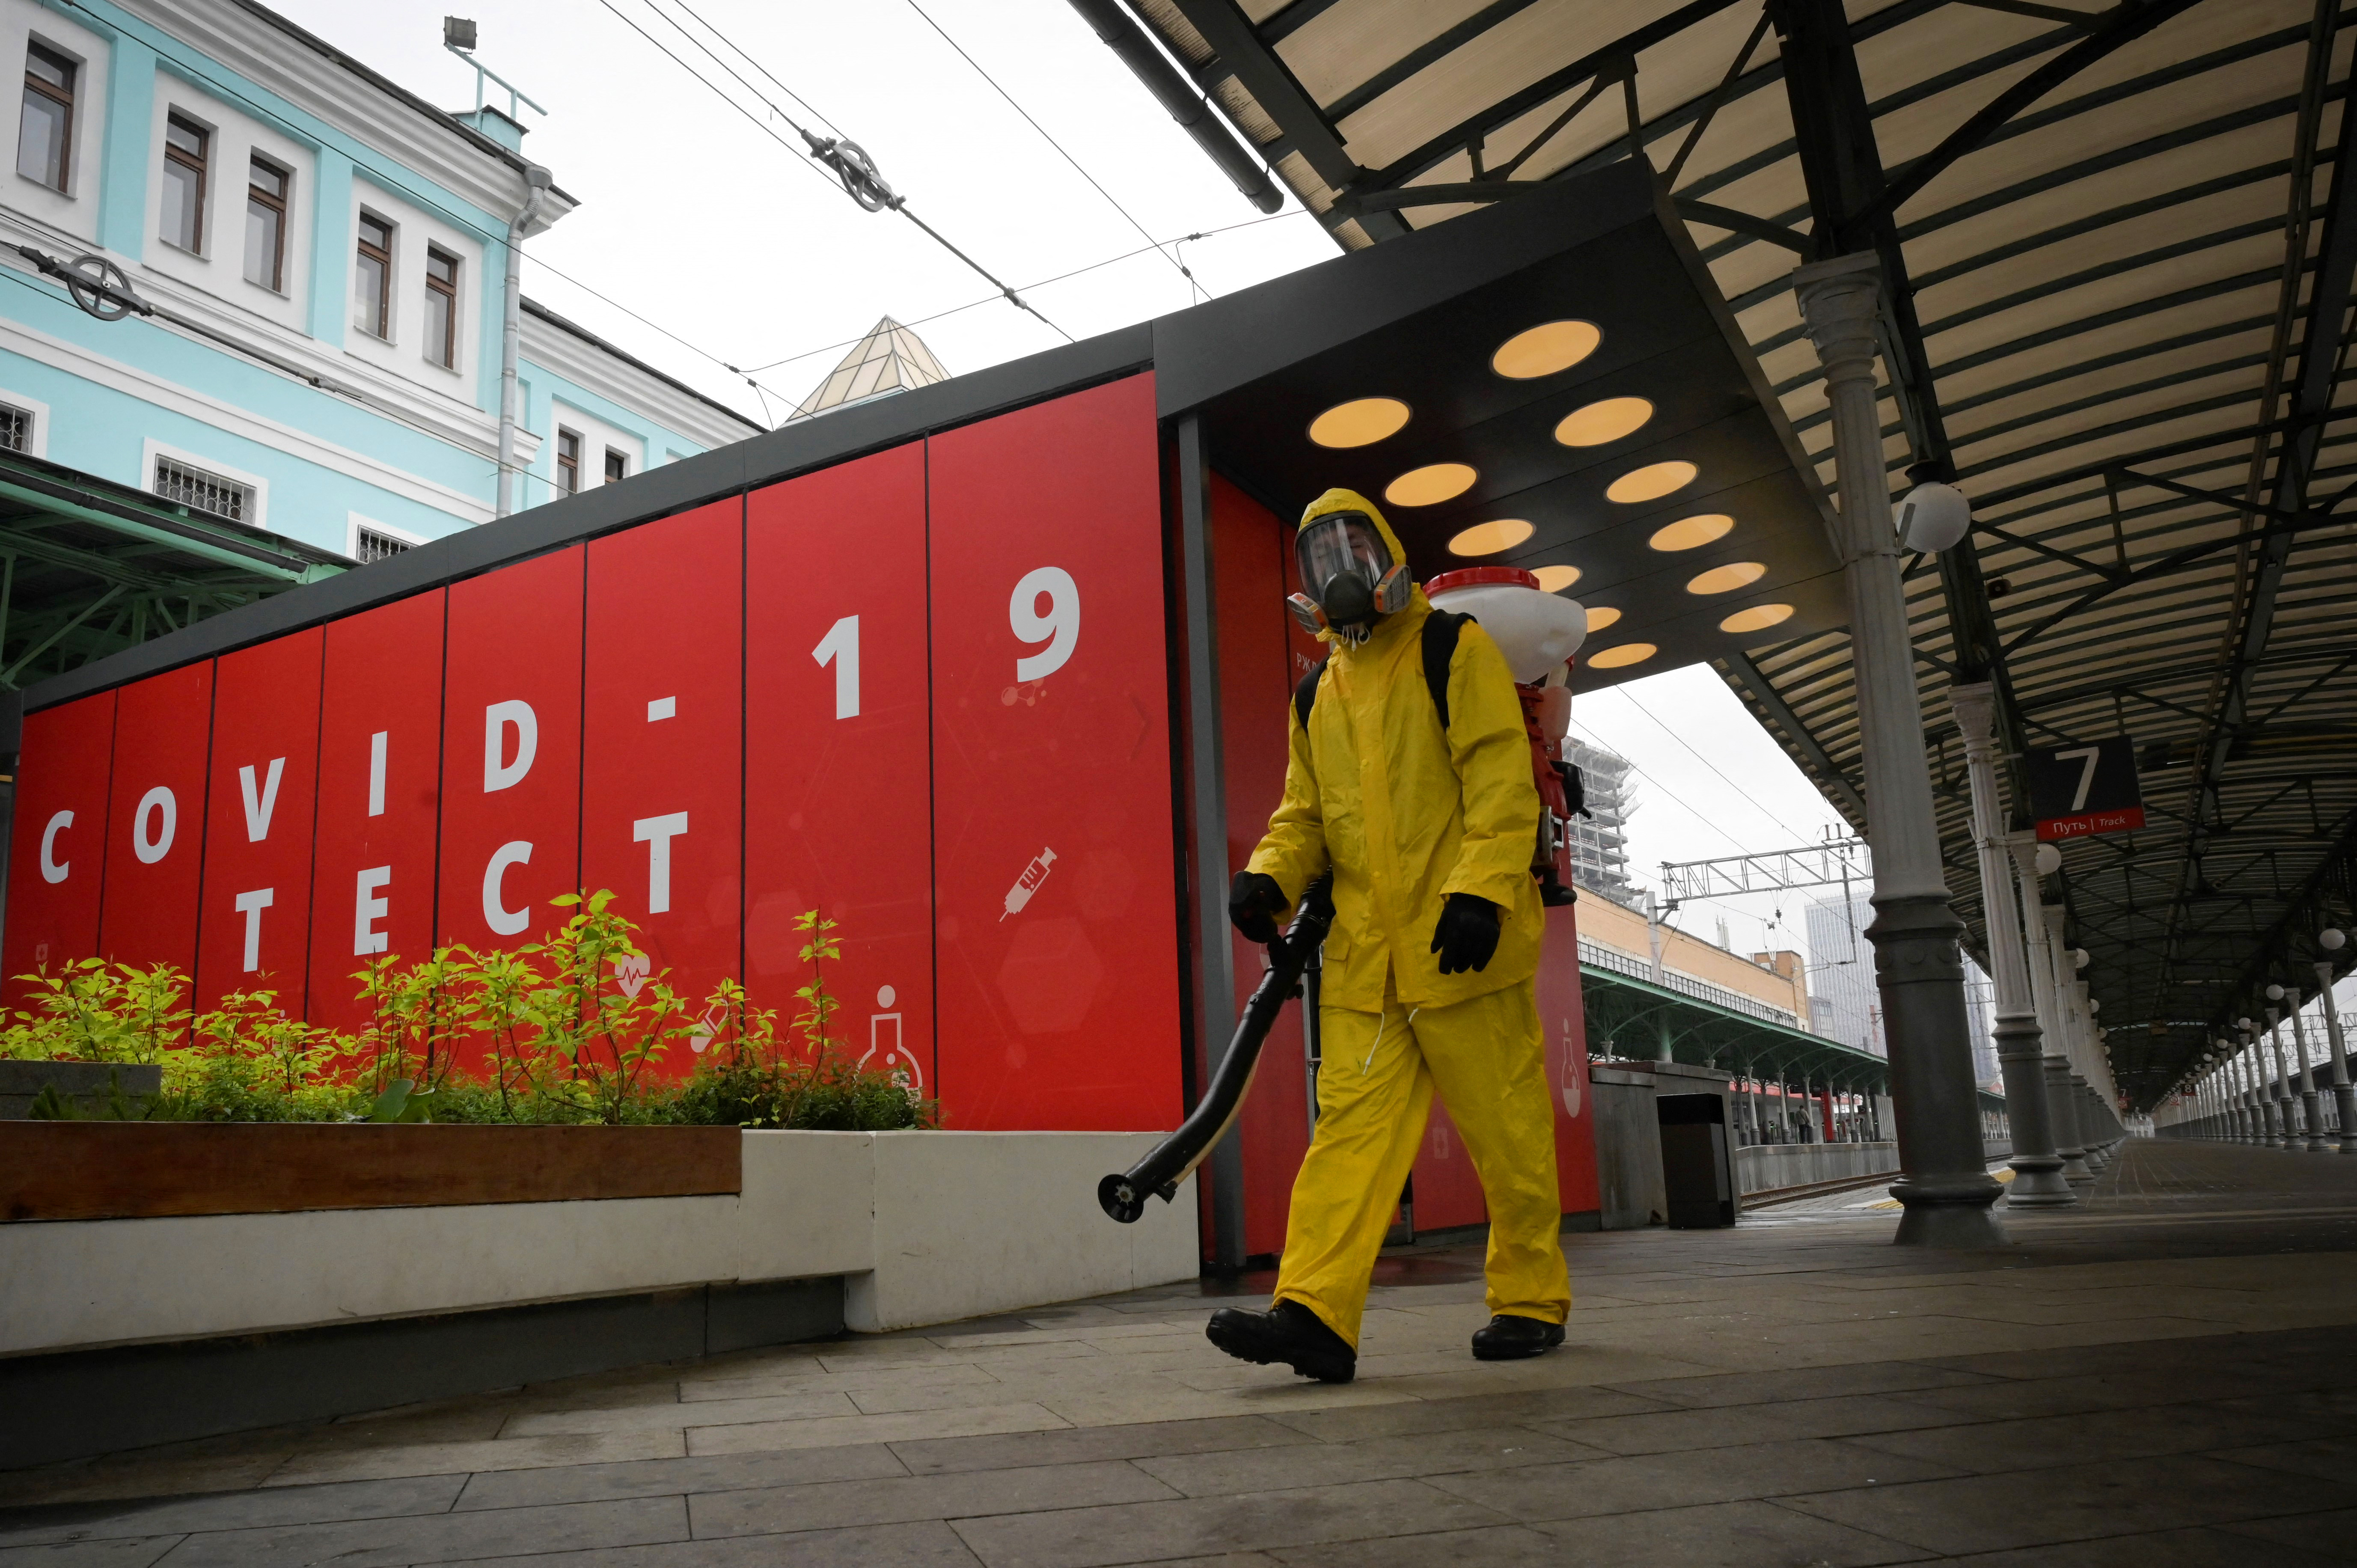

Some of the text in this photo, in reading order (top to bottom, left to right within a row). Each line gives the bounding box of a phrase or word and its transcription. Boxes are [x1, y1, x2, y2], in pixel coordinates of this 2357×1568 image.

[2055, 746, 2099, 811] 7
[2099, 816, 2125, 826] Track
[2053, 822, 2086, 834] Путь
[2120, 1089, 2126, 1097] 7
[2185, 1084, 2192, 1093] 8
